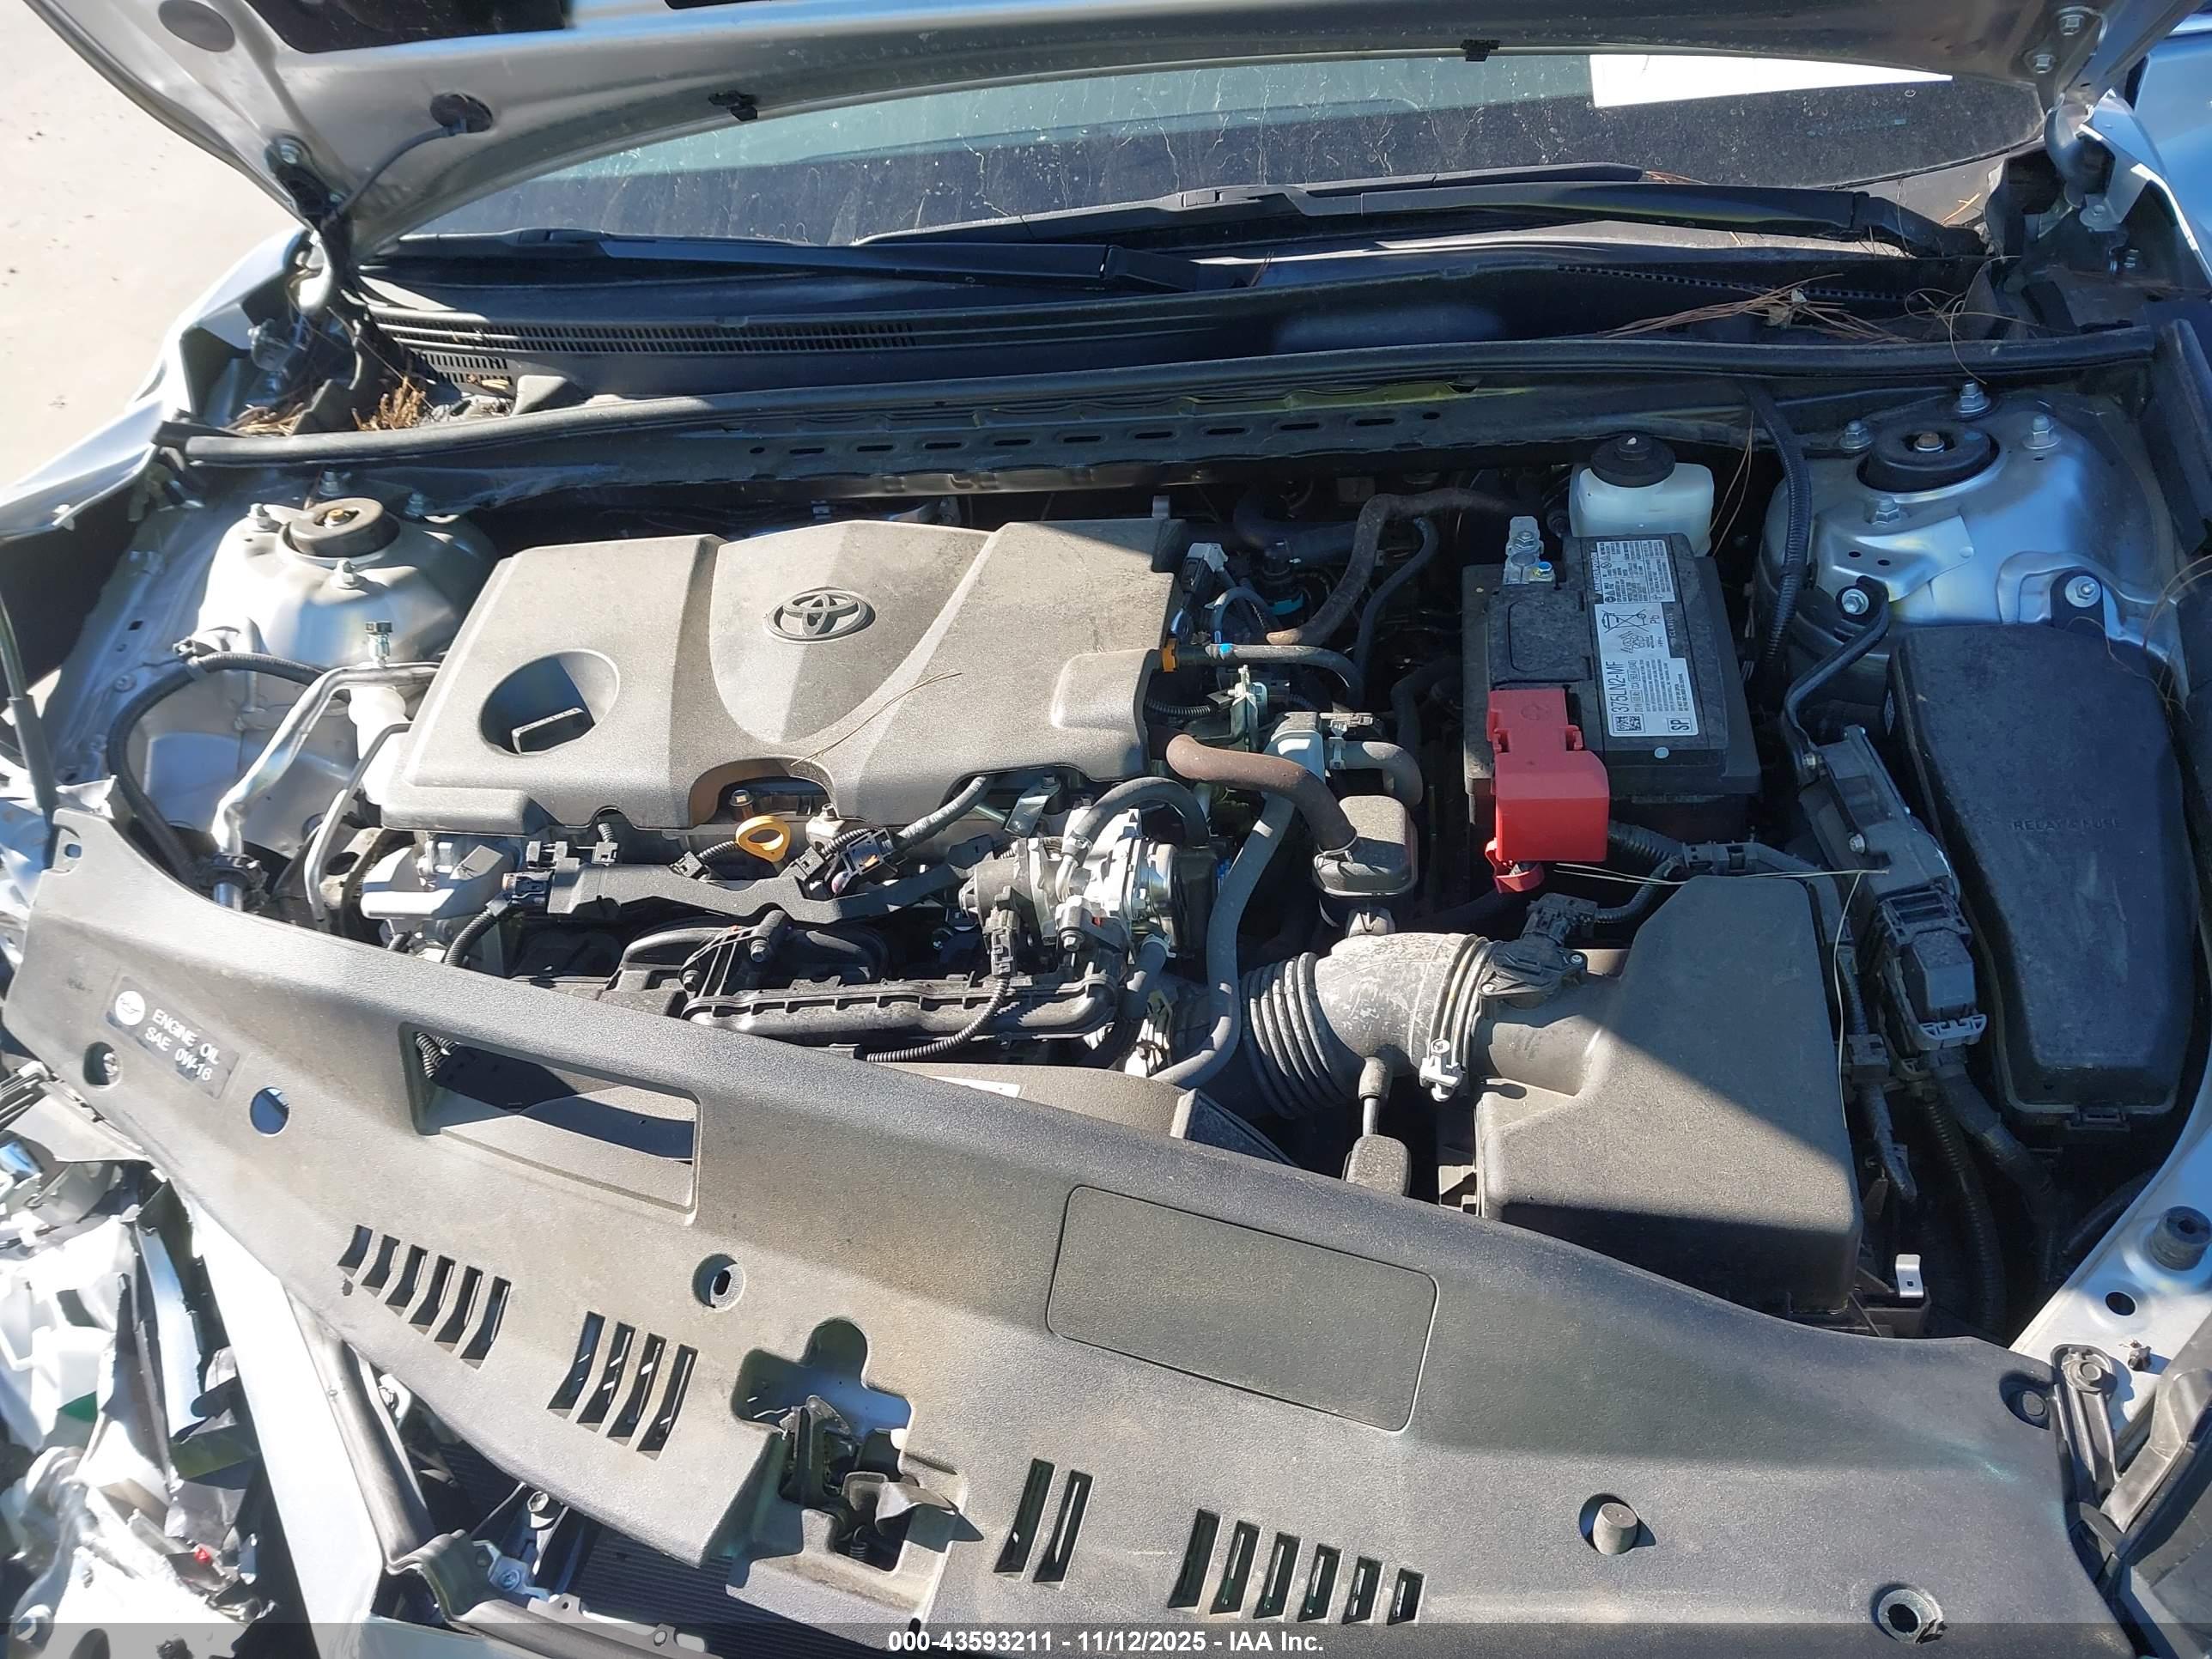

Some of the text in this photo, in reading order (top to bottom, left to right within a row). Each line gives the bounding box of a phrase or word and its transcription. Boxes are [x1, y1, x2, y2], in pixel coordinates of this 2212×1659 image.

[1650, 614, 1662, 624] Pb
[1605, 661, 1630, 713] 375LN2-MF
[1670, 720, 1690, 731] SP
[2012, 818, 2061, 833] RELAY
[2081, 817, 2124, 830] FUSE
[144, 1026, 214, 1081] SAE 0W-16
[152, 1008, 220, 1065] ENGINE OIL
